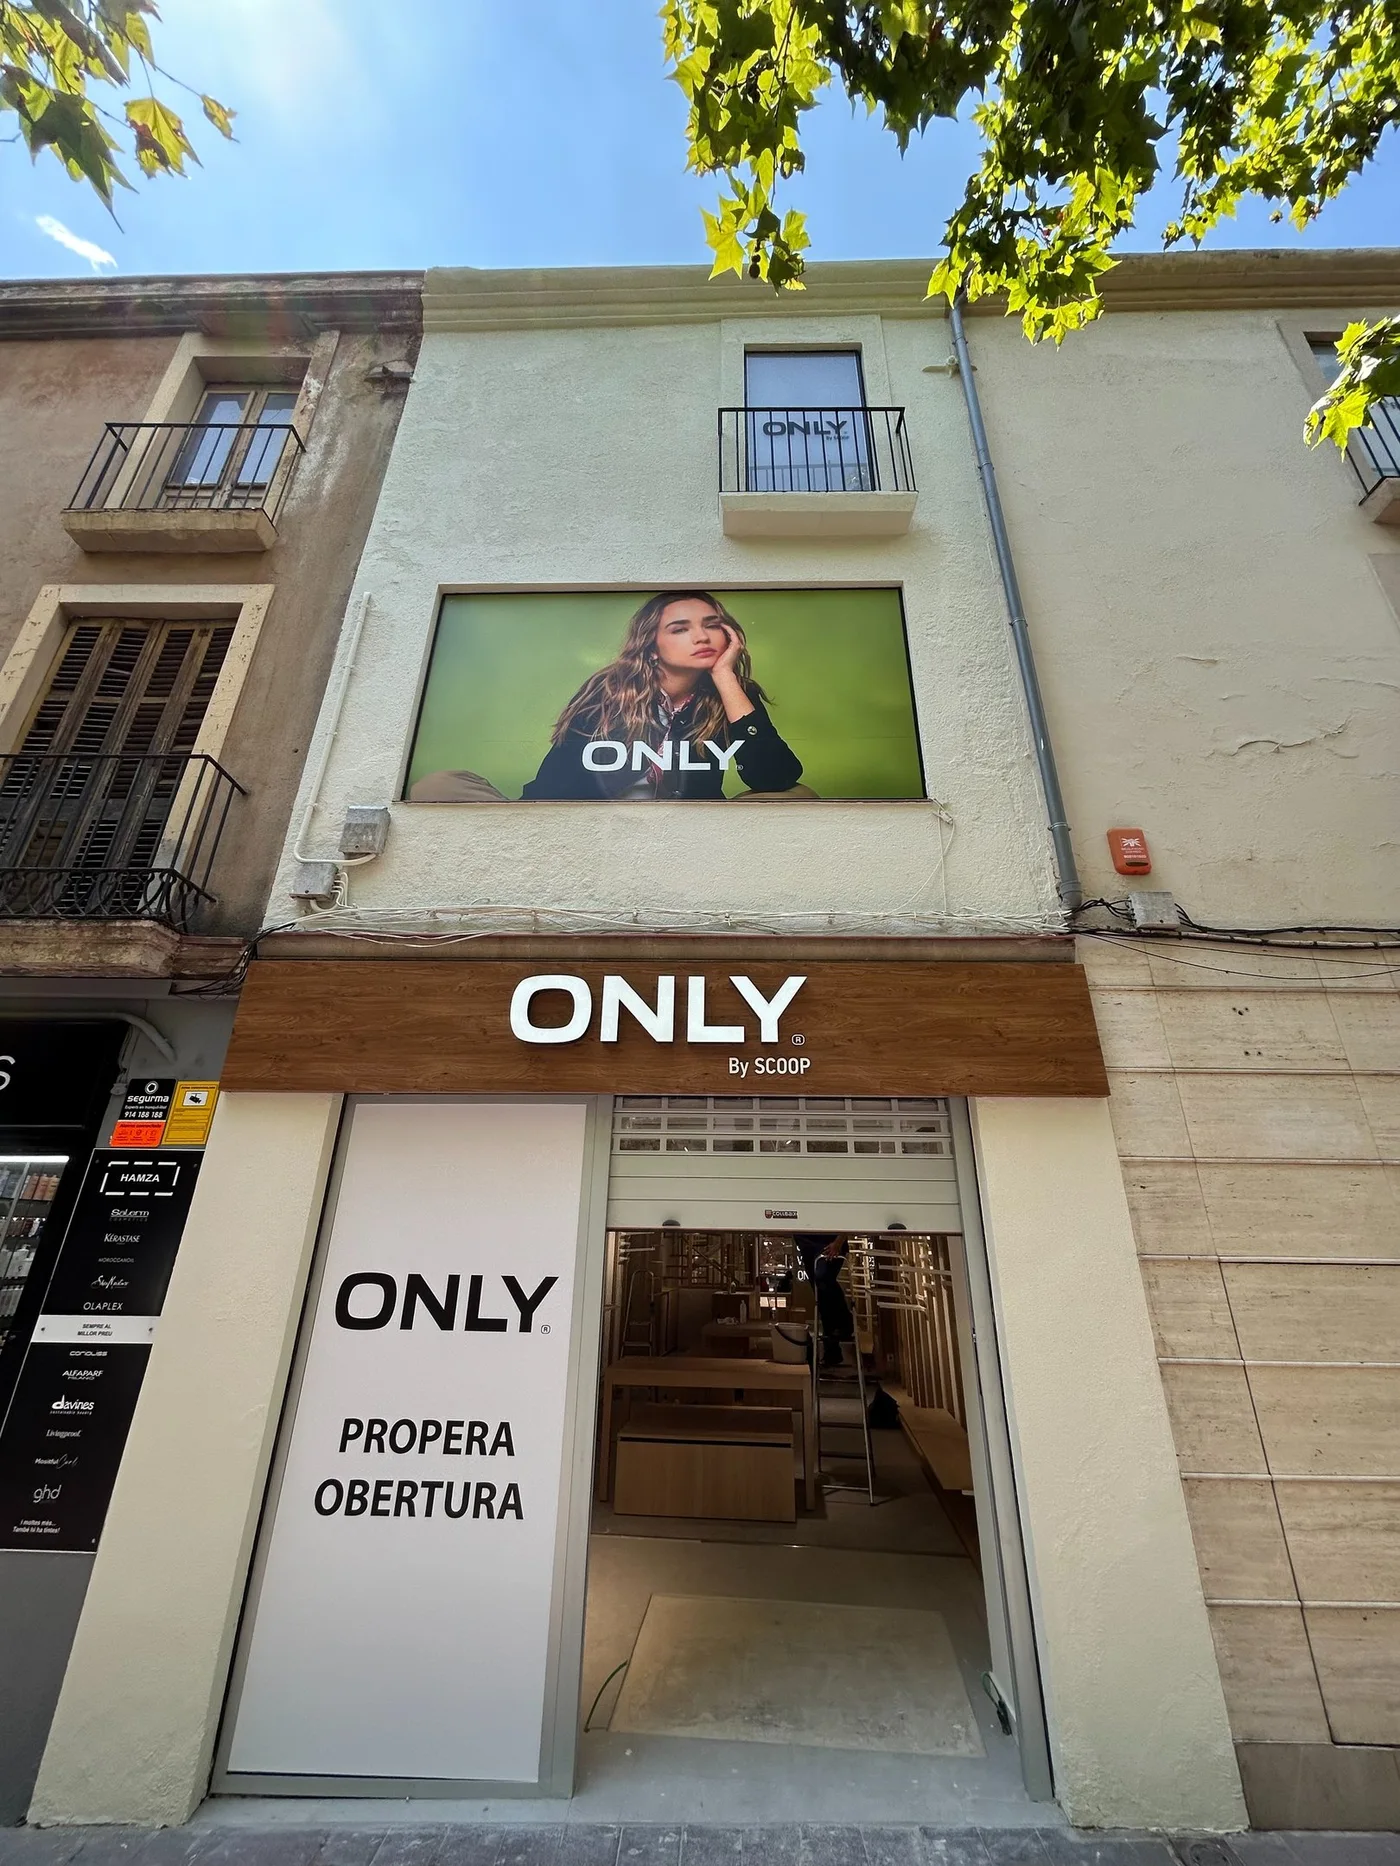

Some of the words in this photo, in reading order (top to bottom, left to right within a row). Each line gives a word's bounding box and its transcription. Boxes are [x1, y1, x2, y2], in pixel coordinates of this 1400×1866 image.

[763, 420, 848, 435] ONLY
[582, 739, 745, 772] ONLY
[509, 974, 808, 1044] ONLY
[728, 1057, 749, 1078] By
[754, 1057, 811, 1075] SCOOP
[126, 1095, 170, 1104] segurma
[138, 1111, 150, 1119] 188
[151, 1111, 164, 1119] 188
[120, 1173, 160, 1183] HAMZA
[83, 1301, 124, 1311] OLAPLEX
[335, 1272, 560, 1333] ONLY
[62, 1369, 104, 1377] ALFAPARF
[51, 1394, 95, 1410] davines
[338, 1418, 516, 1457] PROPERA
[32, 1483, 62, 1503] ghd
[313, 1478, 525, 1520] OBERTURA
